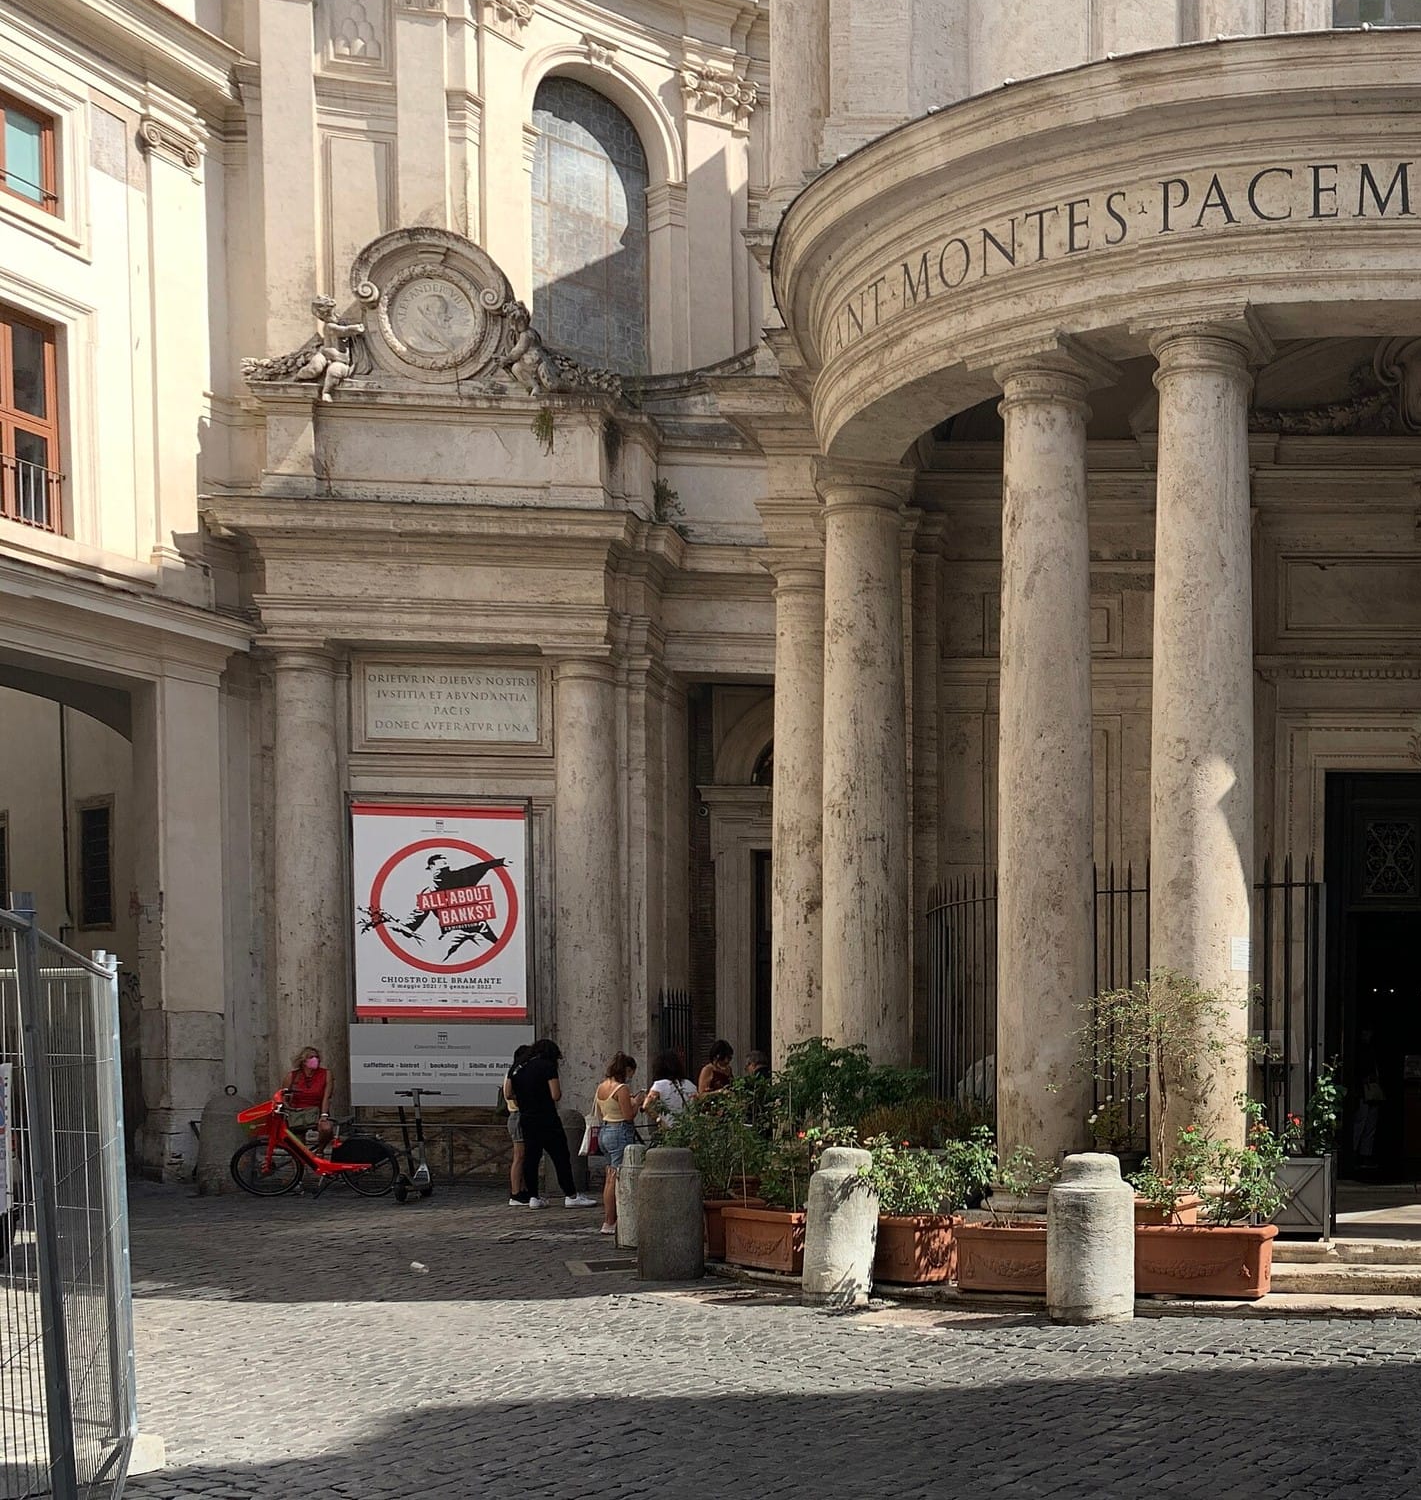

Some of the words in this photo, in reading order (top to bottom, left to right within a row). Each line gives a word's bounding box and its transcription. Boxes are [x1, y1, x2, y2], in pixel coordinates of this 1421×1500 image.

[901, 191, 1128, 310] MONTES
[1160, 162, 1413, 234] PACEM
[368, 673, 420, 684] ORIETVR
[421, 674, 436, 685] IN
[439, 675, 481, 686] DIEBVS
[485, 676, 536, 686] NOSTRIS
[376, 689, 426, 700] IVSTITIA
[429, 690, 443, 700] ET
[446, 691, 528, 702] ABVNDANTIA
[433, 706, 471, 716] PACIS
[375, 720, 420, 730] DONEC
[423, 721, 494, 732] AVFERATVR
[497, 723, 530, 733] LVNA
[421, 893, 445, 909] ALL
[450, 886, 489, 905] ABOUT
[441, 903, 492, 924] BANKSY
[478, 921, 489, 933] 2
[381, 976, 428, 984] CHIOSTRO
[431, 976, 448, 984] DEL
[451, 977, 502, 985] BRAMANTE
